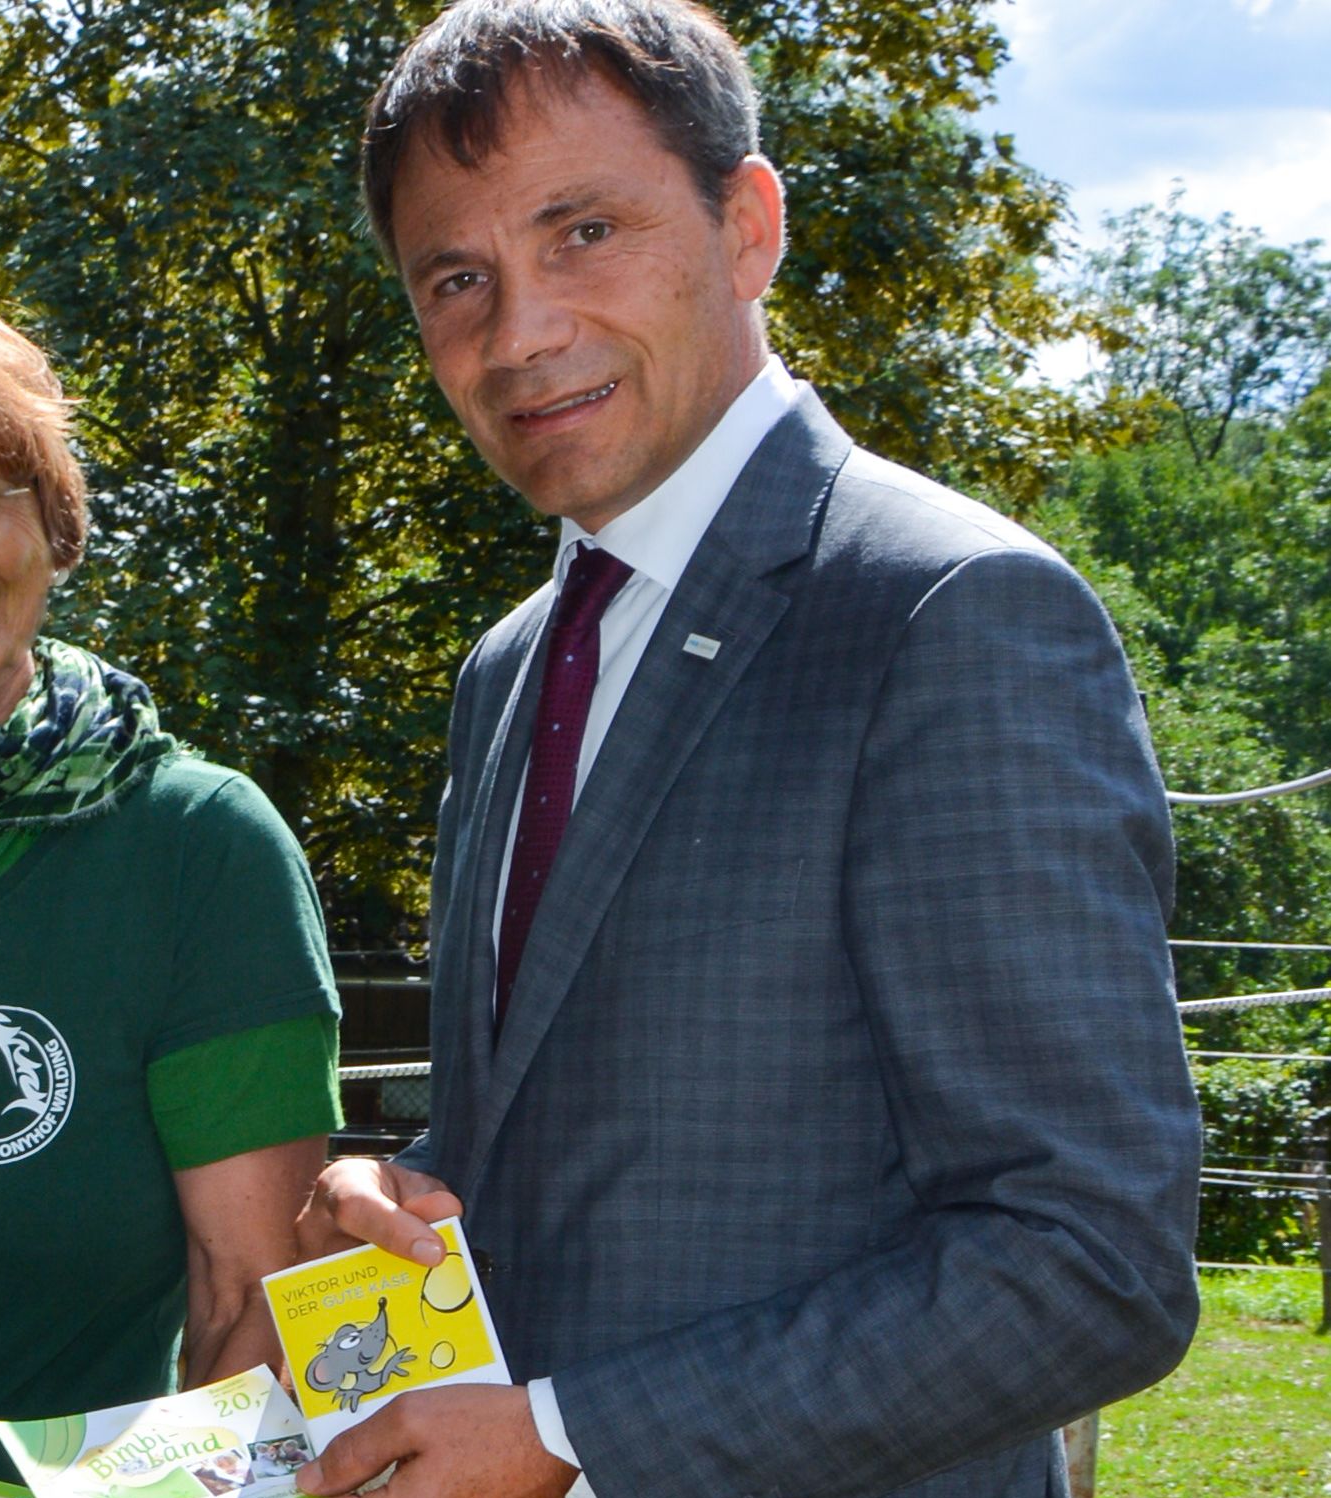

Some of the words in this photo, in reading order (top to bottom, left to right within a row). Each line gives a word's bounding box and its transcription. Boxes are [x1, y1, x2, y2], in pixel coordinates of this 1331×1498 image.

[44, 1038, 70, 1114] WALDING
[282, 1277, 340, 1304] VIKTOR
[344, 1266, 378, 1285] UND
[287, 1301, 319, 1320] DER
[321, 1286, 365, 1308] GUTE
[87, 1429, 179, 1480] Bimbi-
[146, 1432, 224, 1468] Land
